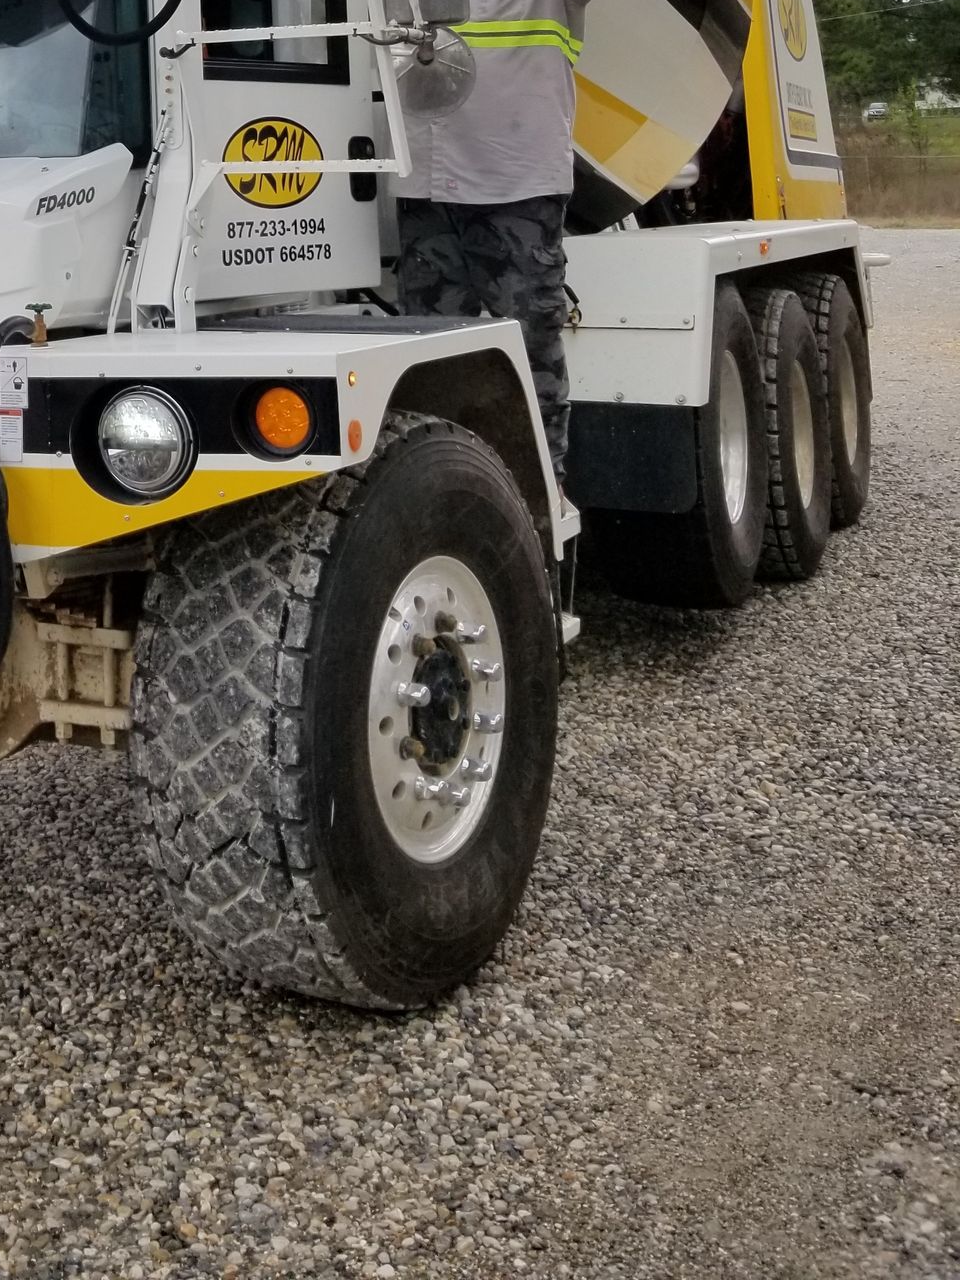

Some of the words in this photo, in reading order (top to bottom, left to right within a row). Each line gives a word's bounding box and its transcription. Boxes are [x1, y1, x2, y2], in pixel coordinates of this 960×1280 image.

[239, 125, 306, 195] SRM
[36, 186, 95, 216] FD4000
[227, 218, 325, 239] 877-233-1994
[222, 247, 274, 266] USDOT
[280, 243, 332, 262] 664578
